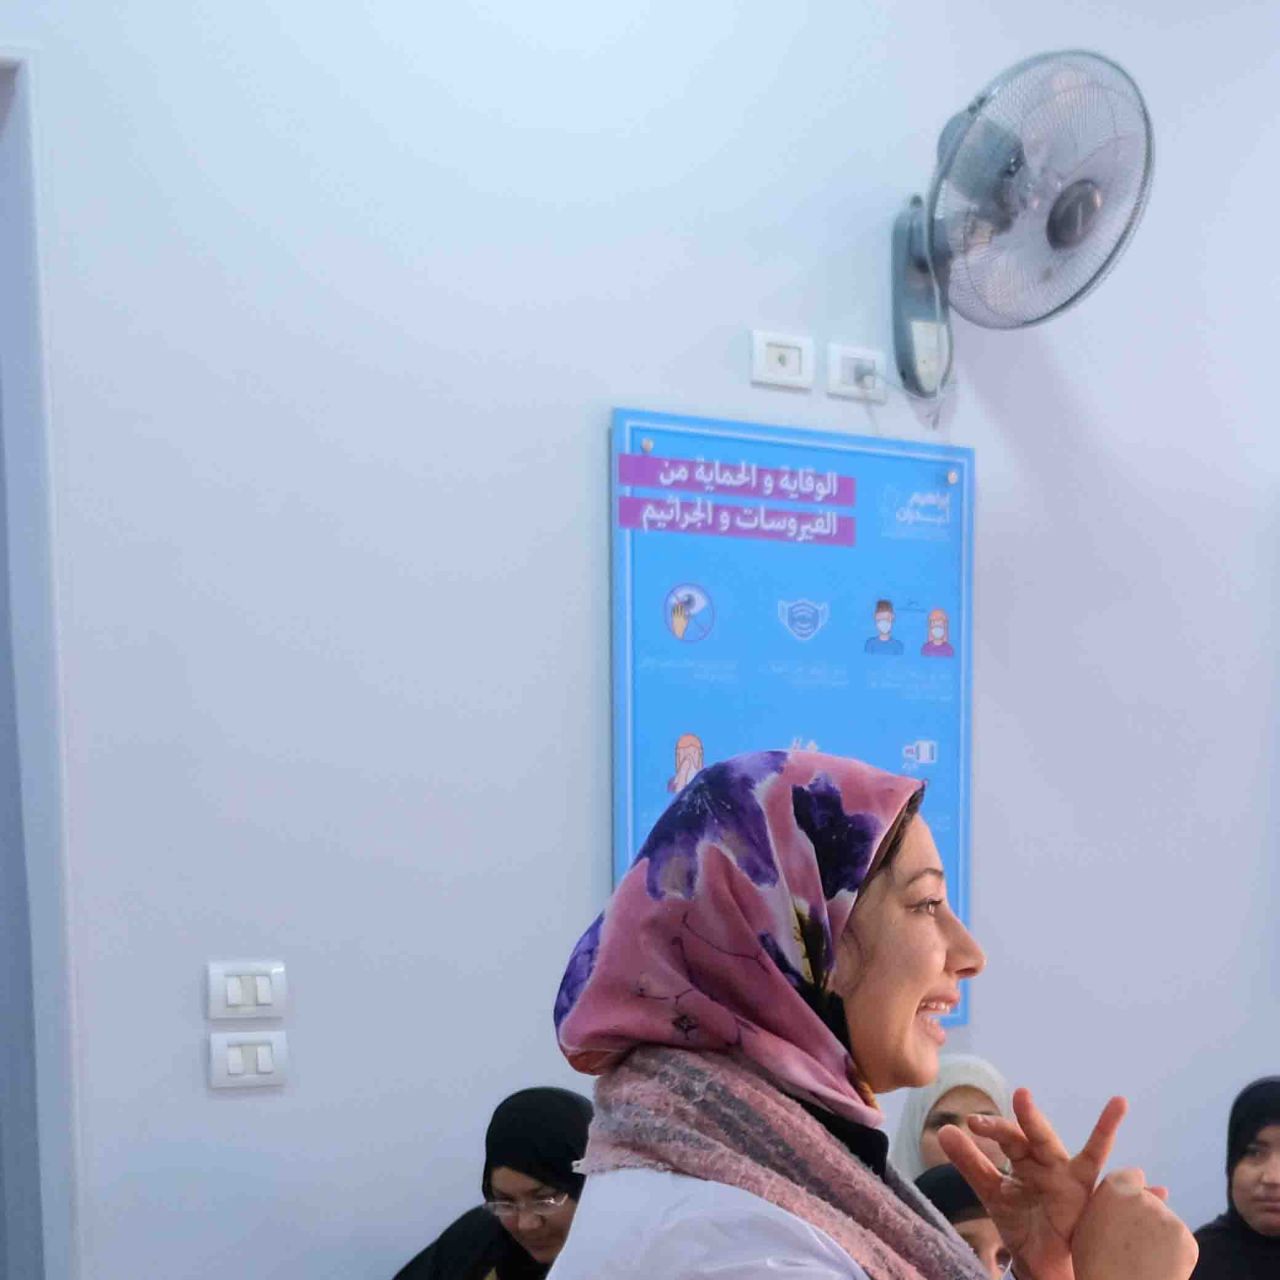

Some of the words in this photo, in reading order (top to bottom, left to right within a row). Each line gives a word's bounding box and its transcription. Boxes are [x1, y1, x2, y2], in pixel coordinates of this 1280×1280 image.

[659, 460, 688, 486] من
[695, 456, 757, 492] الحماية
[763, 473, 774, 496] و
[780, 465, 838, 501] الوقاية
[642, 496, 713, 534] الجراثيم
[719, 511, 730, 532] و
[736, 505, 838, 542] الفيروسات
